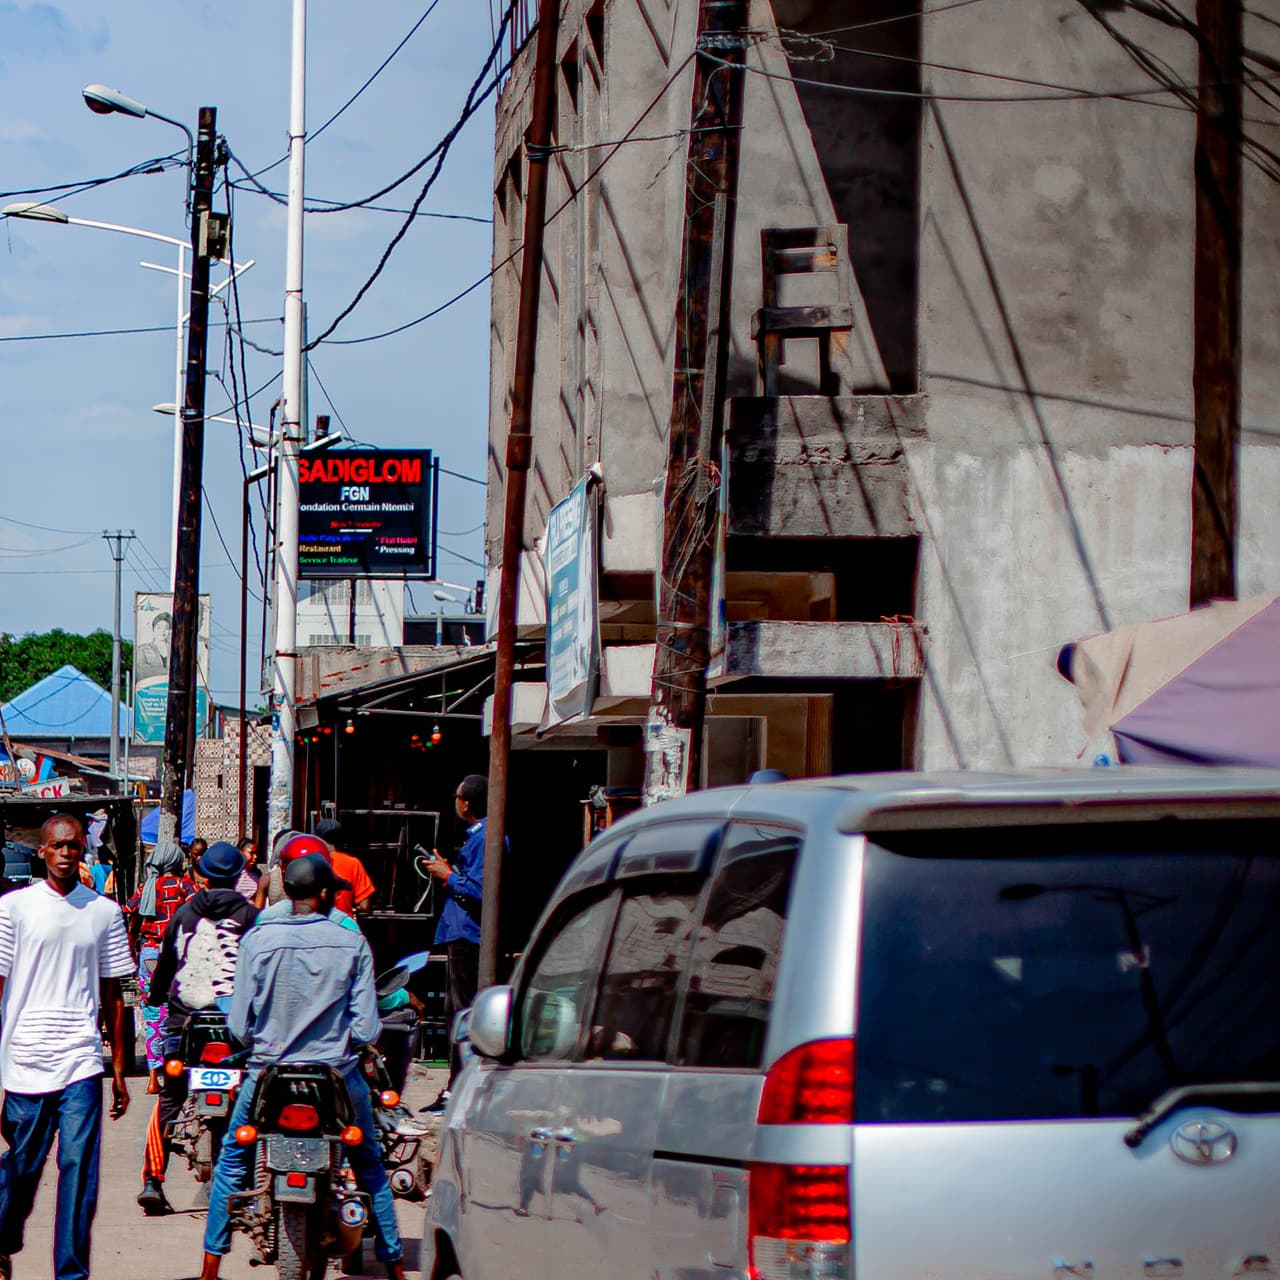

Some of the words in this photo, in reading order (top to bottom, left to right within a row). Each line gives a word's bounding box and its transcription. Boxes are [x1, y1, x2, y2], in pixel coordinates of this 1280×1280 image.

[299, 458, 421, 483] SADIGLOM
[340, 486, 369, 501] FGN
[299, 502, 340, 512] ondation
[342, 502, 380, 512] Germain
[381, 502, 414, 512] Ntembi
[380, 546, 415, 555] Pressing
